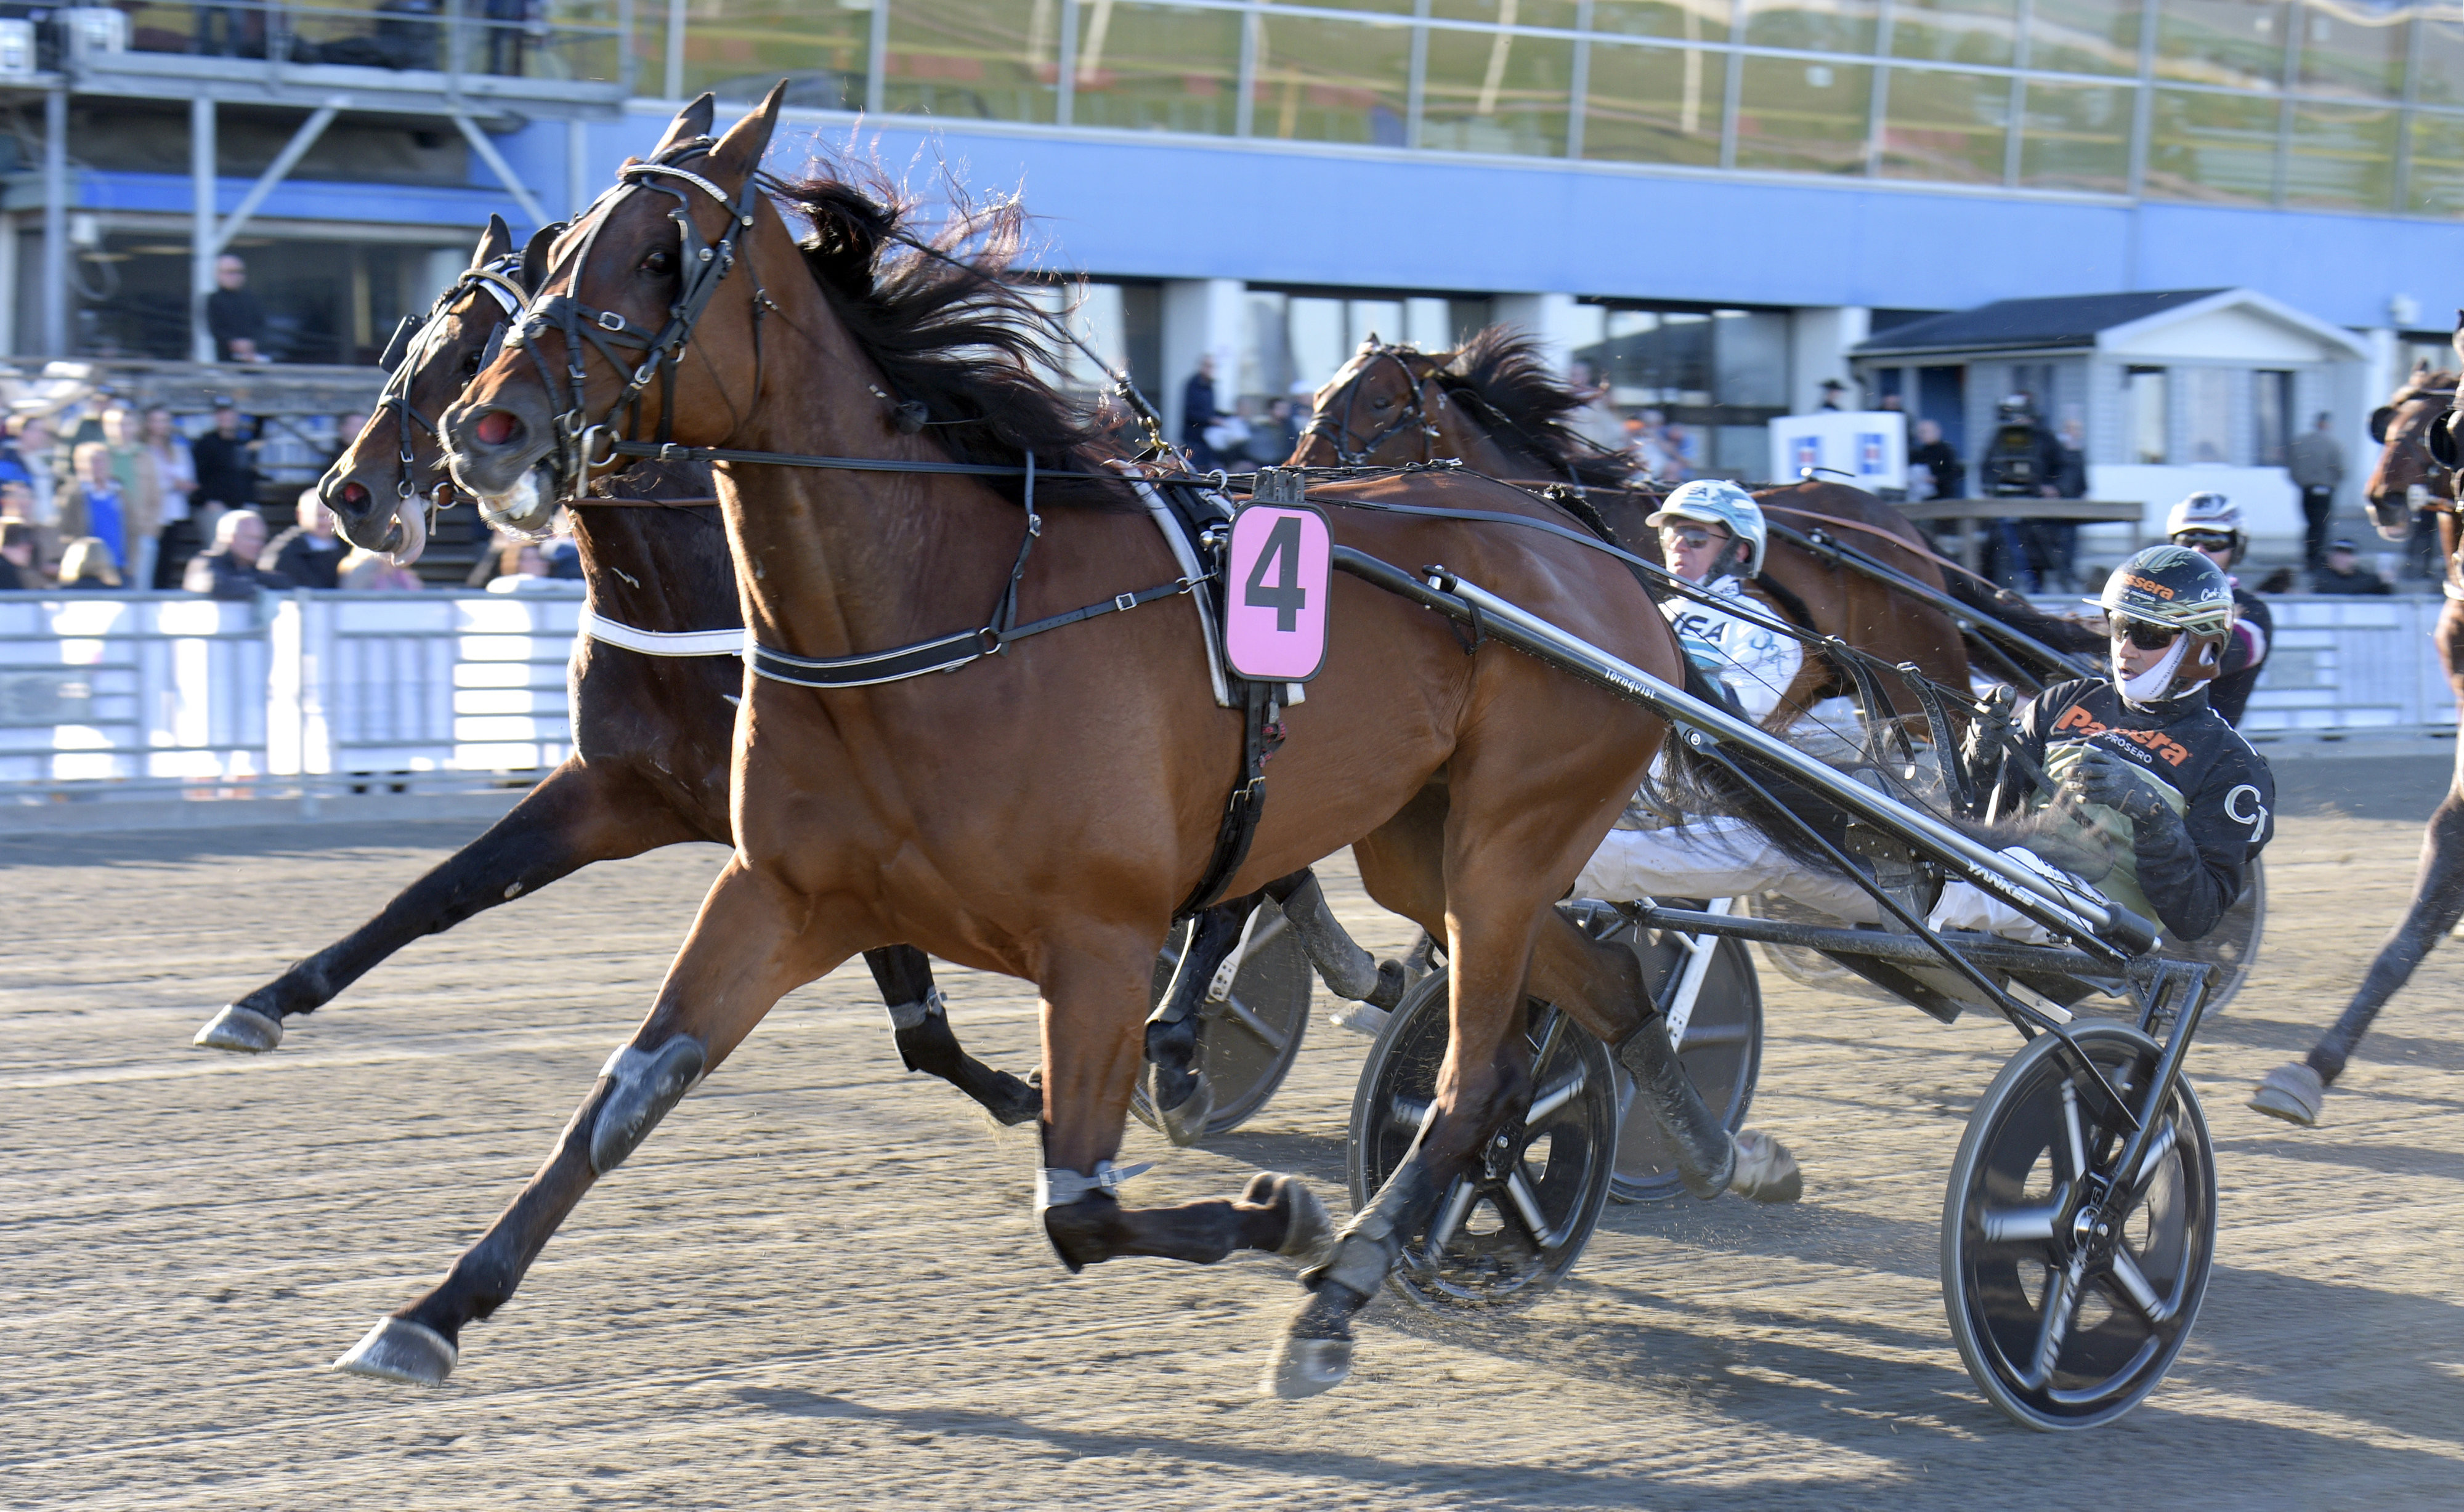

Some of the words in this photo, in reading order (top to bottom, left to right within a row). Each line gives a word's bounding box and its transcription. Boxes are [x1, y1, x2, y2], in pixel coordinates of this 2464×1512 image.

[1244, 516, 1306, 633] 4
[2123, 572, 2175, 601] ssera
[2056, 705, 2189, 767] Paera
[2104, 735, 2154, 764] PROSERO
[1967, 859, 2036, 907] YANKEE
